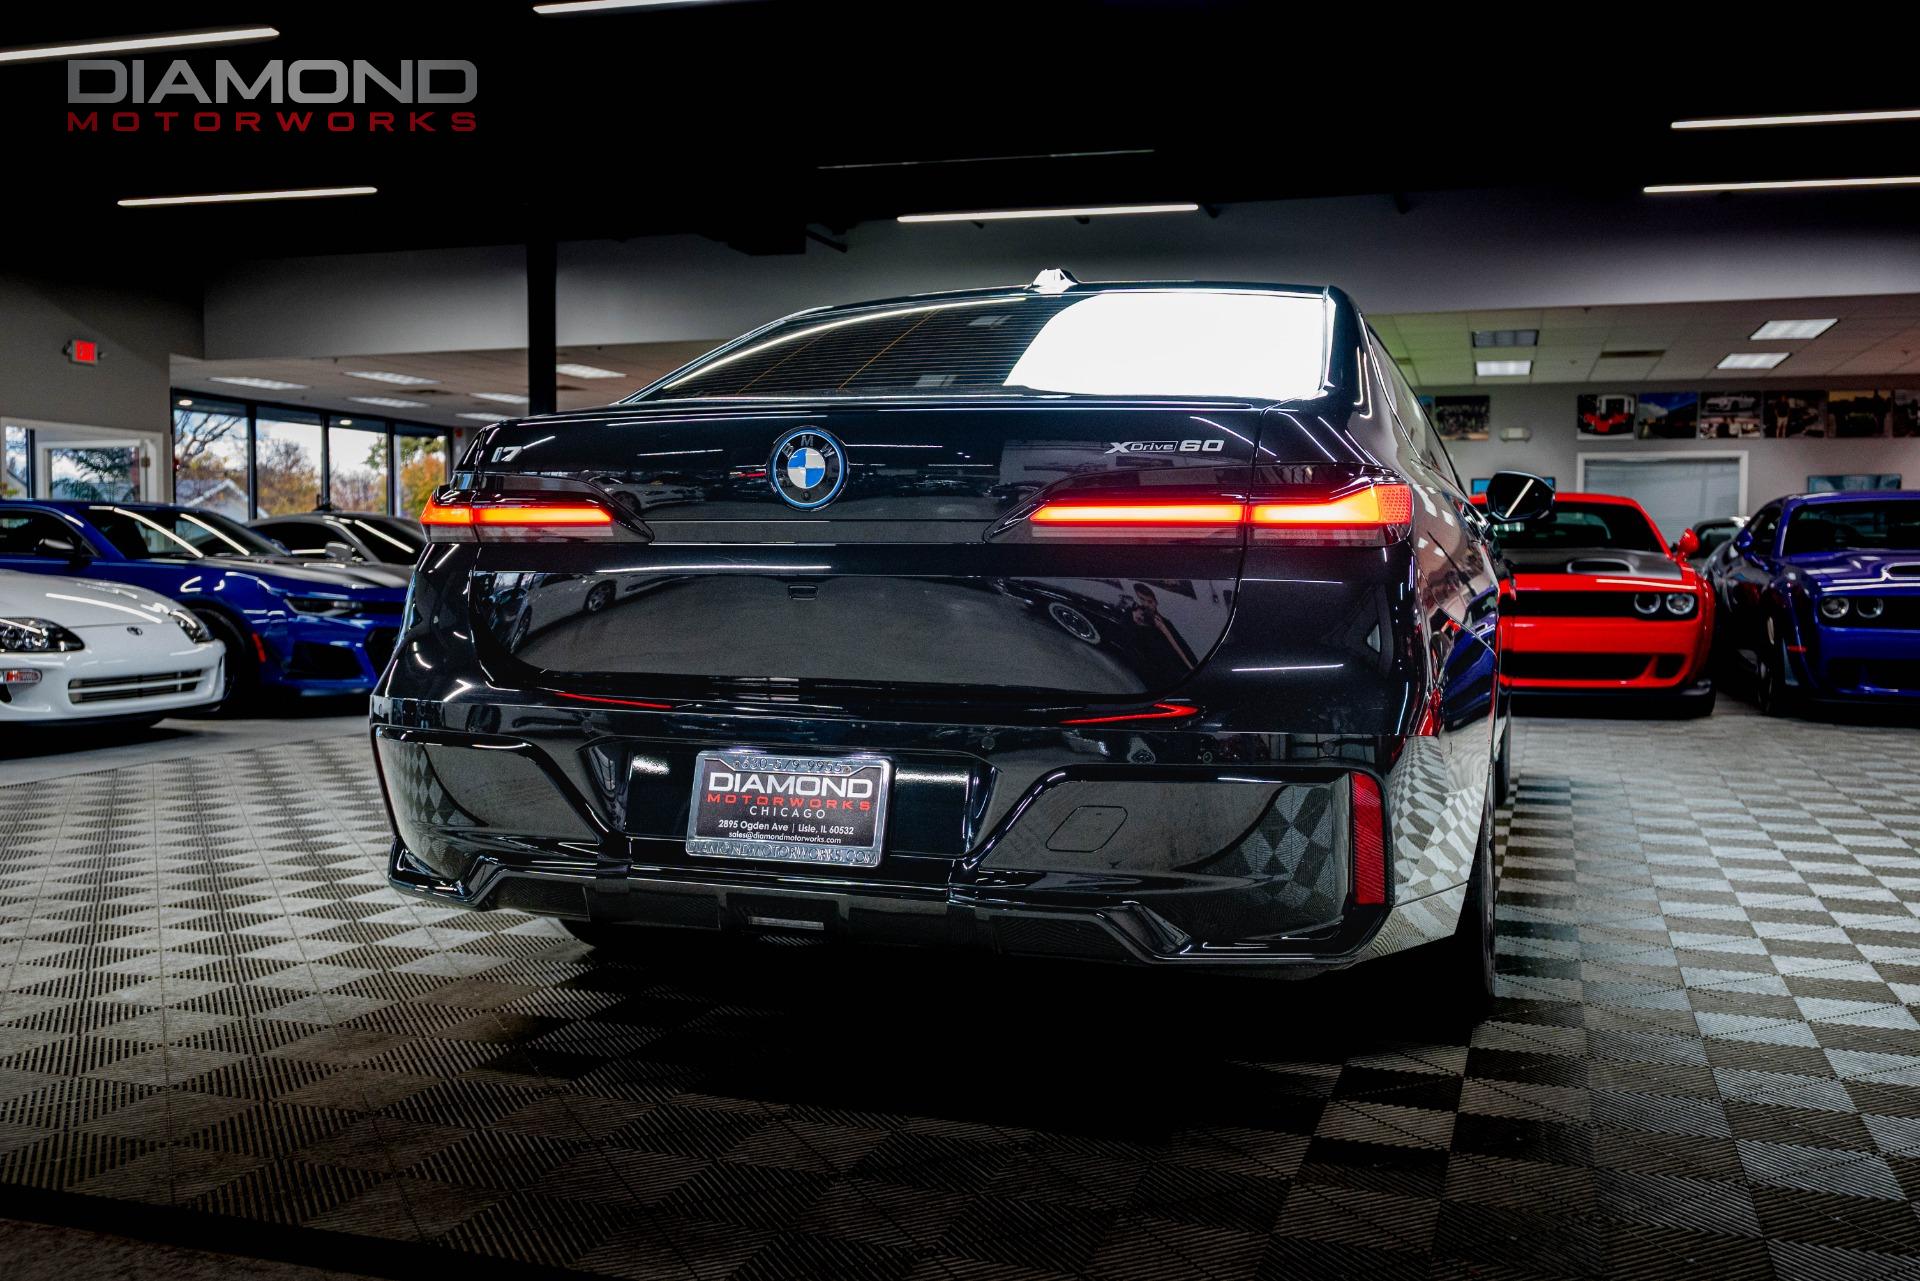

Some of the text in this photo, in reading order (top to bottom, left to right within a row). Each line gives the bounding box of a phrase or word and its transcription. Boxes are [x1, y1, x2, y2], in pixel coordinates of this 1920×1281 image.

[781, 434, 836, 459] BMW
[708, 772, 873, 798] DIAMOND
[707, 793, 871, 812] MOTORWORKS
[749, 805, 826, 819] CHICAGO
[718, 819, 738, 829] 2895
[740, 820, 769, 831] Ogden
[771, 822, 788, 832] Ave
[820, 825, 827, 834] IL
[829, 826, 854, 835] 60532
[728, 831, 841, 844] sales@diamondmotorworks.com
